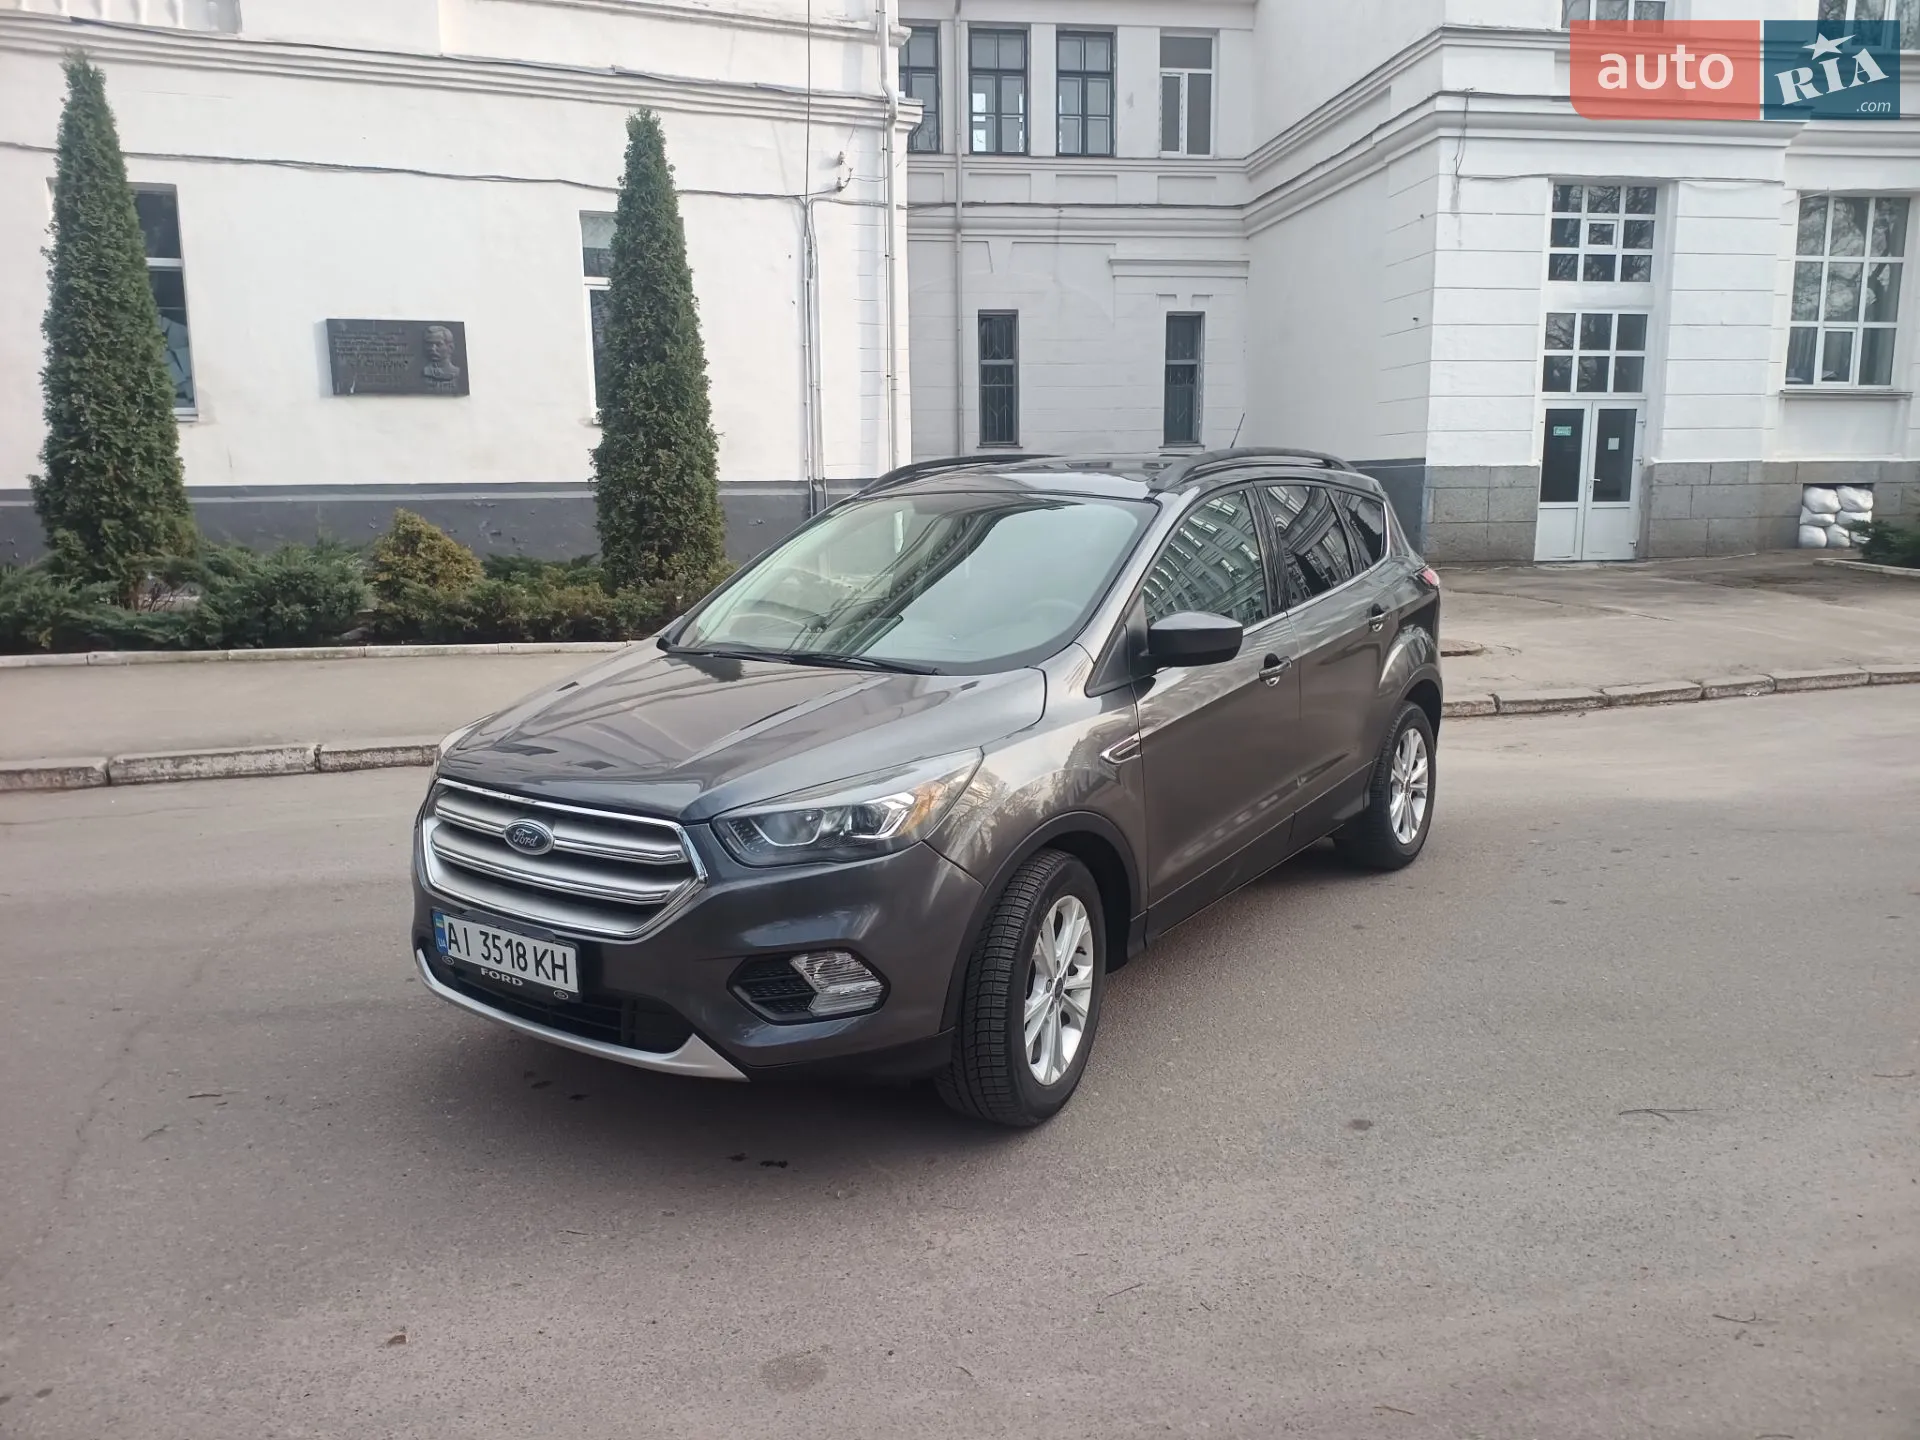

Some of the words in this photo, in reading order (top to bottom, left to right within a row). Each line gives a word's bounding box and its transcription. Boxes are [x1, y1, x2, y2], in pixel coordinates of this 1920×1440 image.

[513, 828, 538, 847] Ford
[448, 922, 470, 956] AI
[480, 930, 528, 972] 3518
[533, 945, 568, 984] KH
[480, 967, 523, 986] FORD
